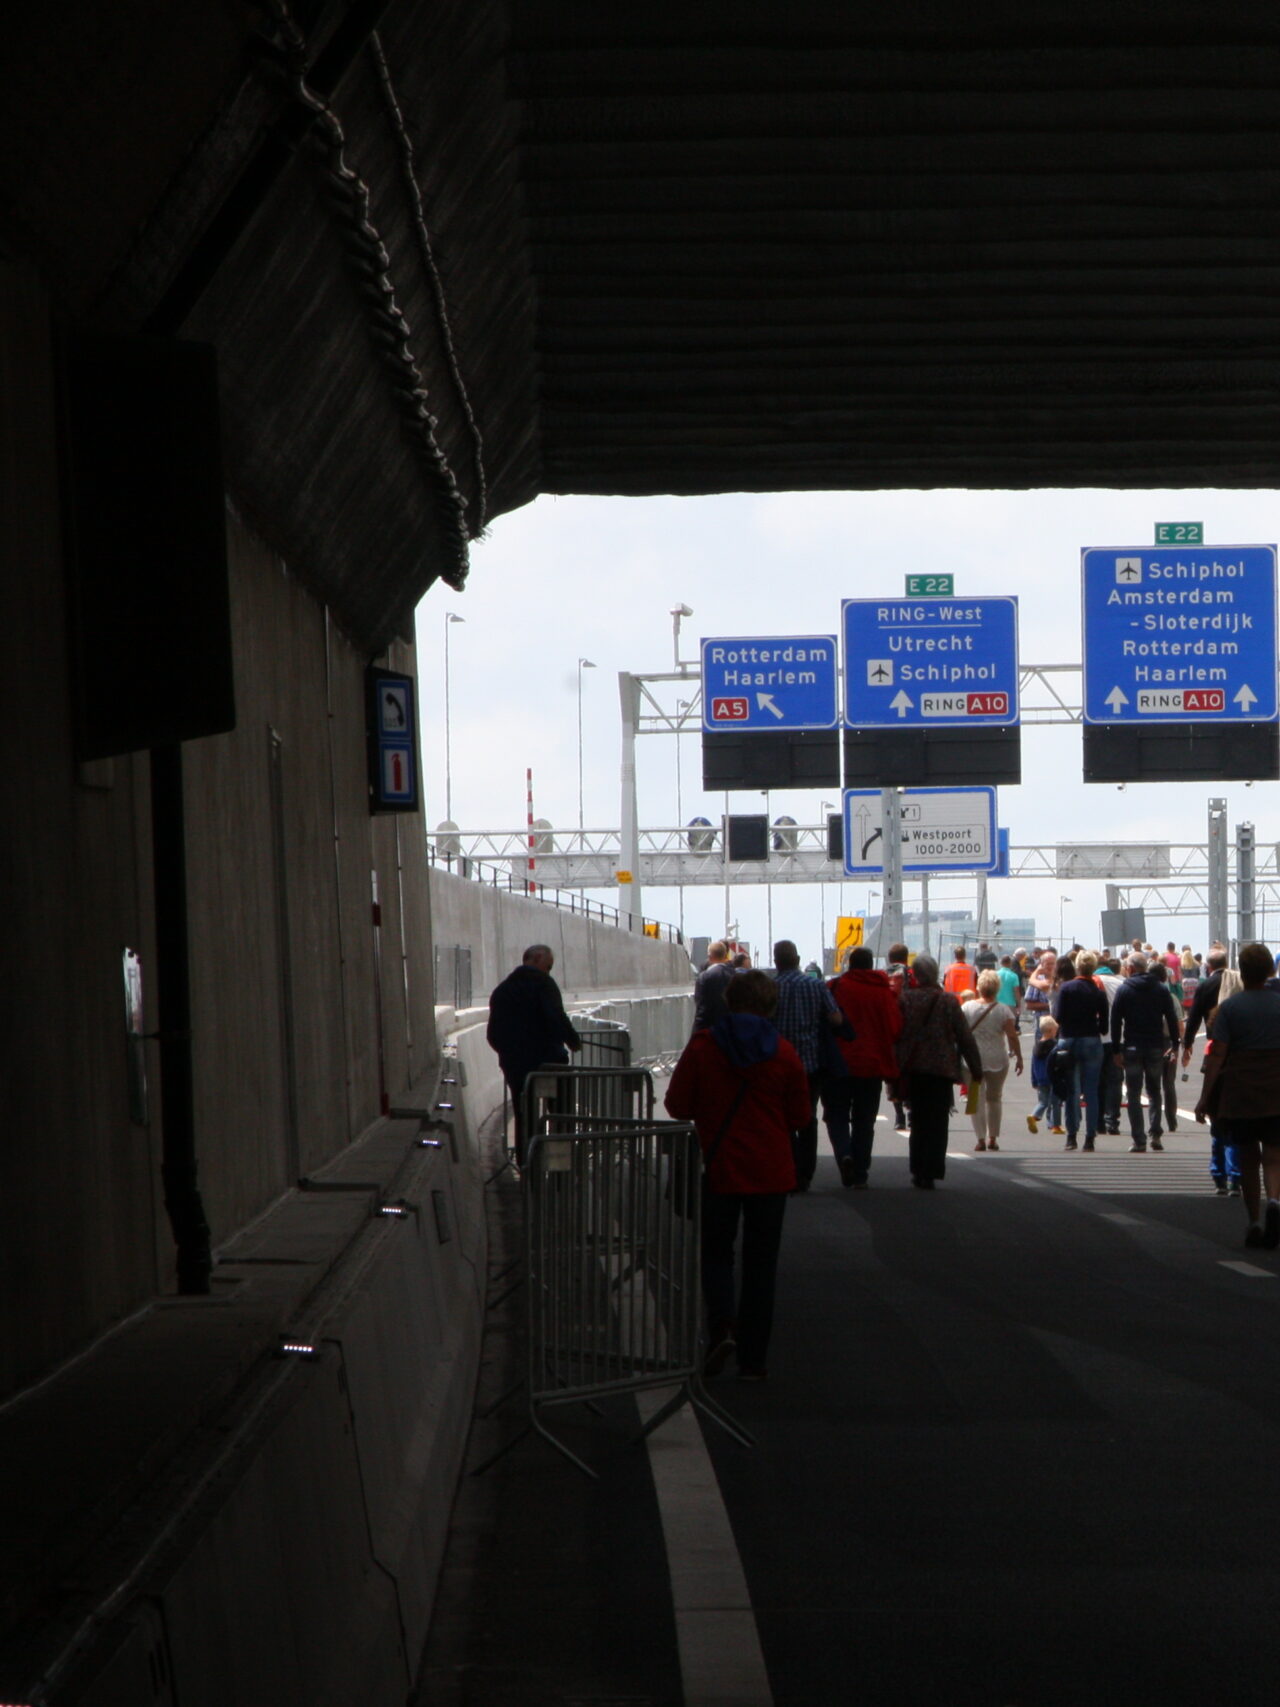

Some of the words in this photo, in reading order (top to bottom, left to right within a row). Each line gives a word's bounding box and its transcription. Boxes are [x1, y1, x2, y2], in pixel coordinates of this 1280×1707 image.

[1158, 526, 1170, 541] E
[1174, 526, 1199, 541] 22
[1148, 561, 1244, 580] Schiphol
[909, 578, 920, 592] E
[925, 577, 950, 592] 22
[1107, 588, 1234, 605] Amsterdam
[877, 606, 982, 621] RING-West
[888, 634, 973, 651] Utrecht
[1123, 639, 1239, 655] Rotterdam
[712, 646, 827, 664] Rotterdam
[724, 669, 816, 686] Haarlem
[900, 663, 996, 683] Schiphol
[1135, 665, 1227, 682] Haarlem
[923, 698, 965, 711] RING
[970, 696, 1005, 711] A10
[1140, 694, 1182, 707] RING
[1186, 693, 1221, 707] A10
[716, 701, 745, 716] A5
[912, 829, 973, 841] Westpoort
[915, 842, 982, 855] 1000-2000
